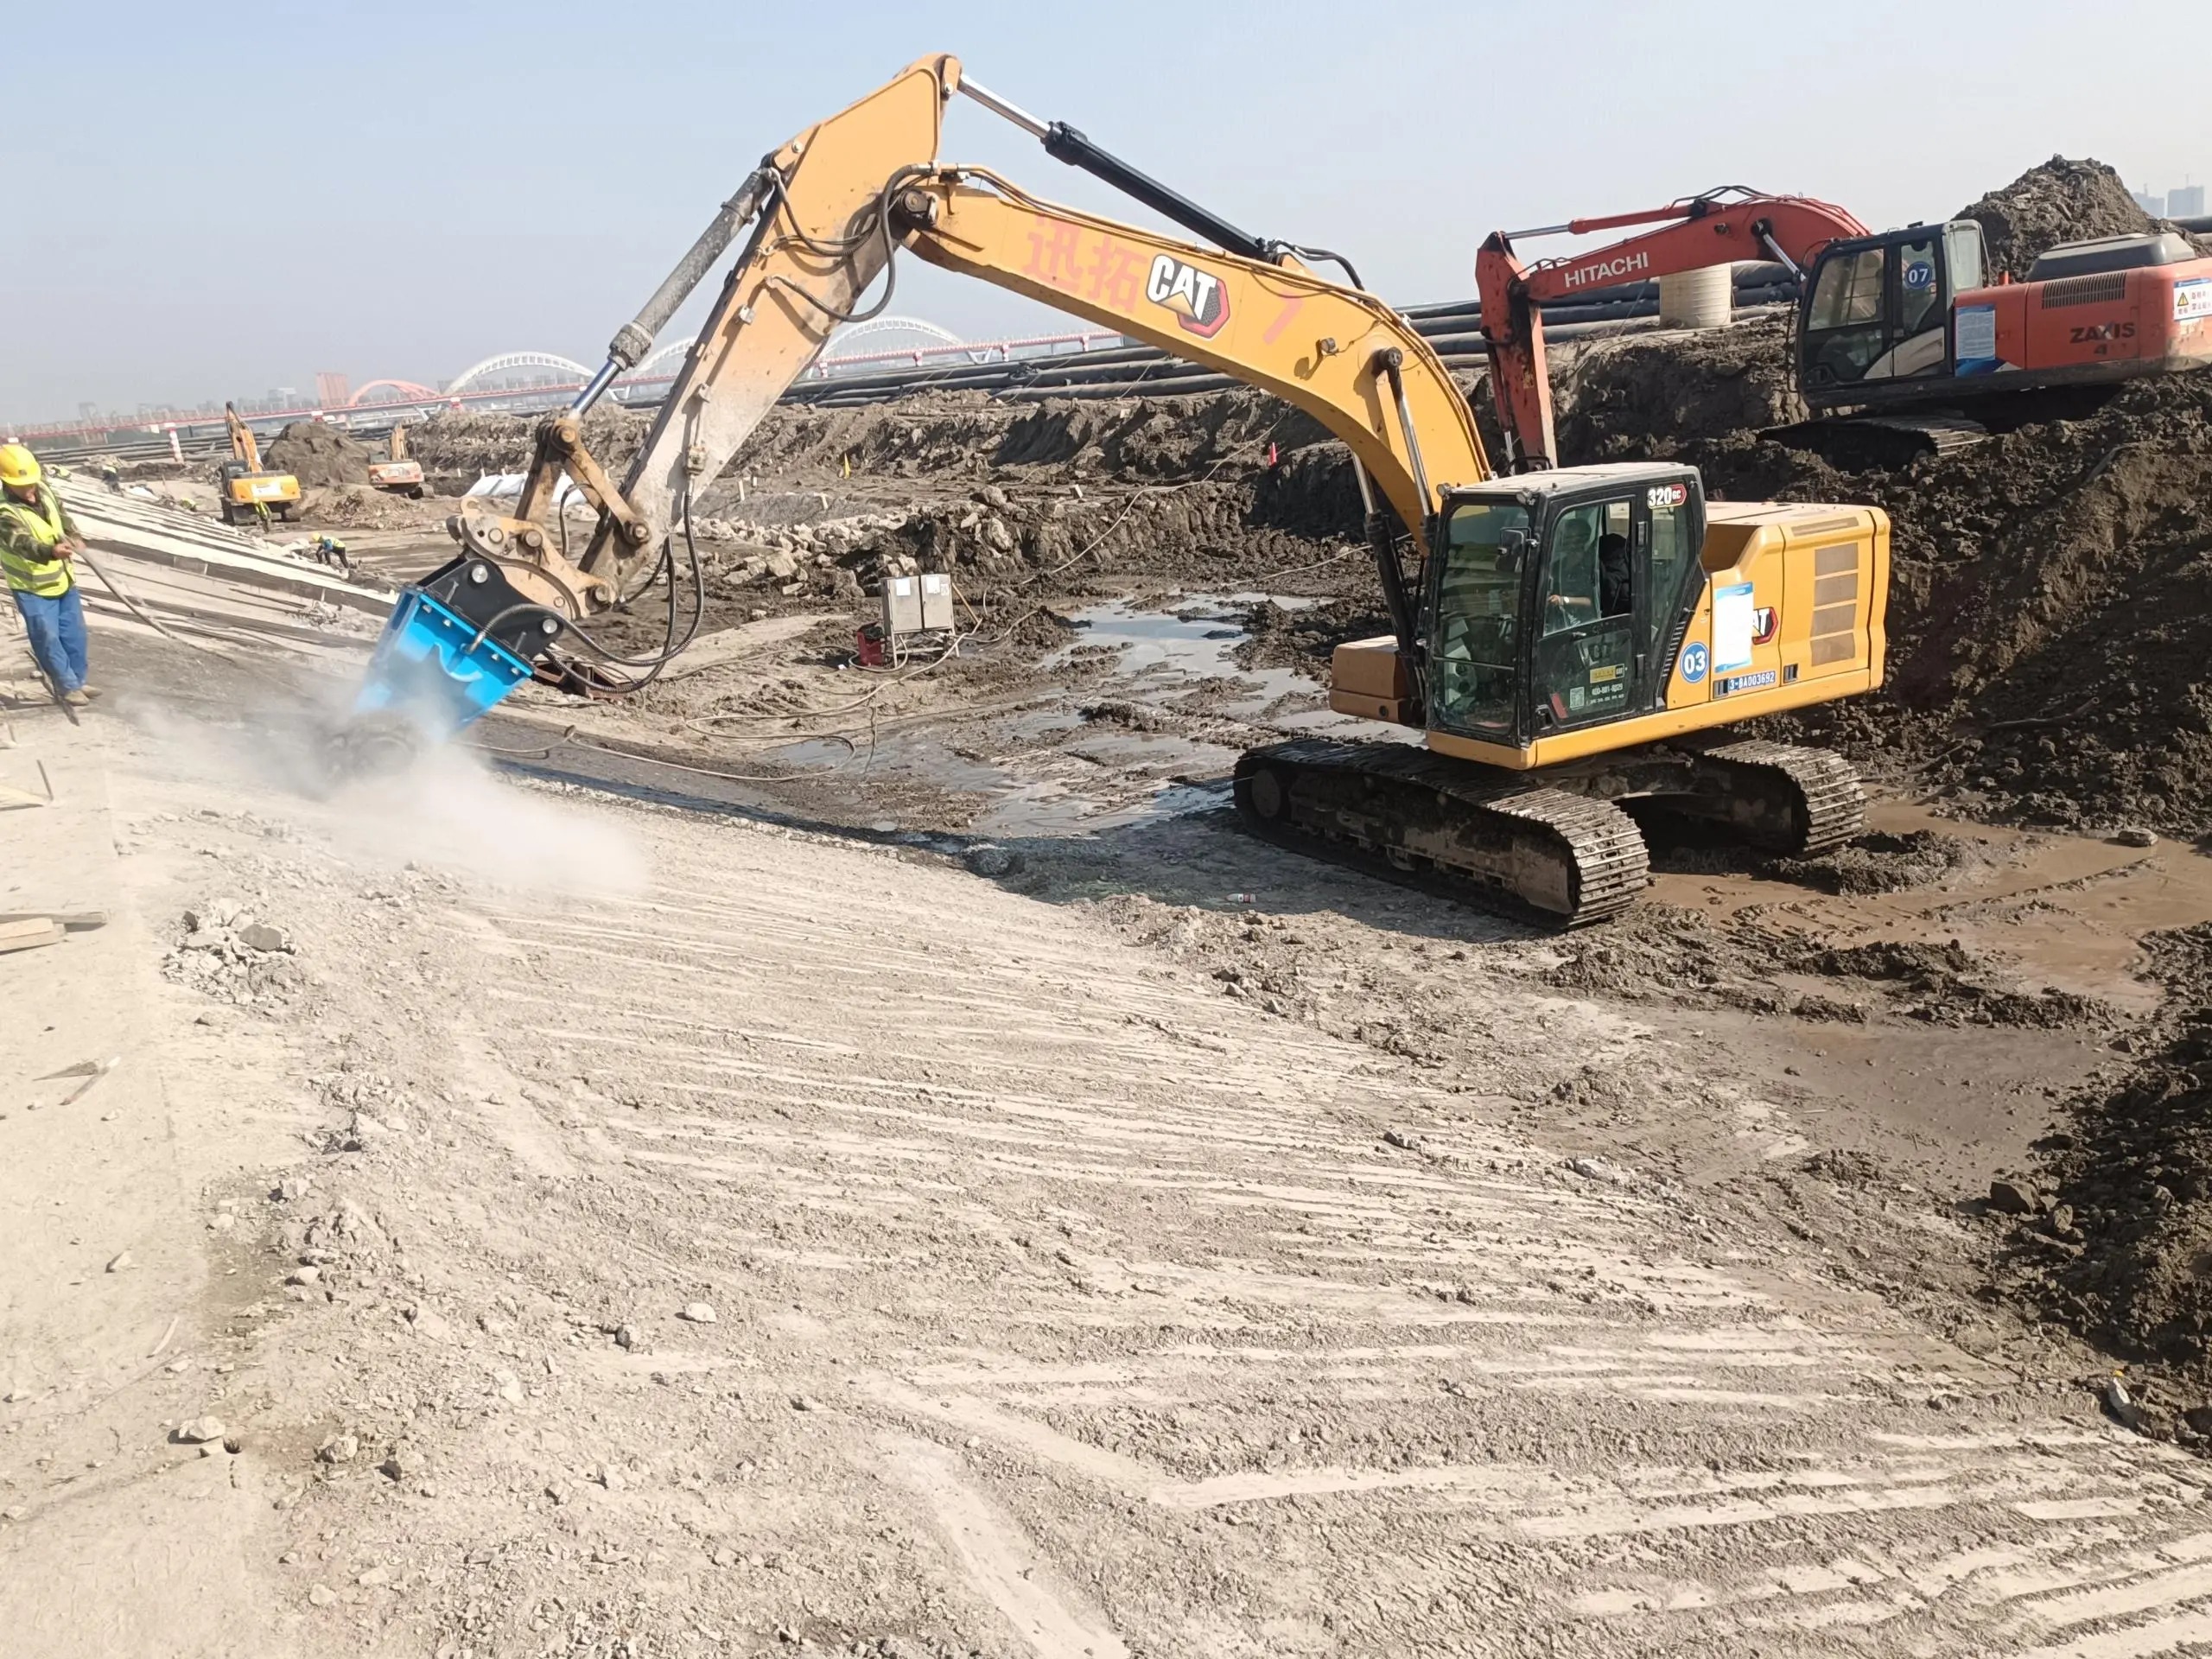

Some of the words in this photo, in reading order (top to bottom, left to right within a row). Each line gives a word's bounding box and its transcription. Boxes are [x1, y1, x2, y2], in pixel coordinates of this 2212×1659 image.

[1564, 251, 1649, 288] HITACHI
[1909, 268, 1929, 283] 07
[1147, 255, 1217, 321] CAT
[2069, 321, 2135, 344] ZAXIS
[1647, 486, 1673, 507] 320
[1684, 651, 1706, 675] 03
